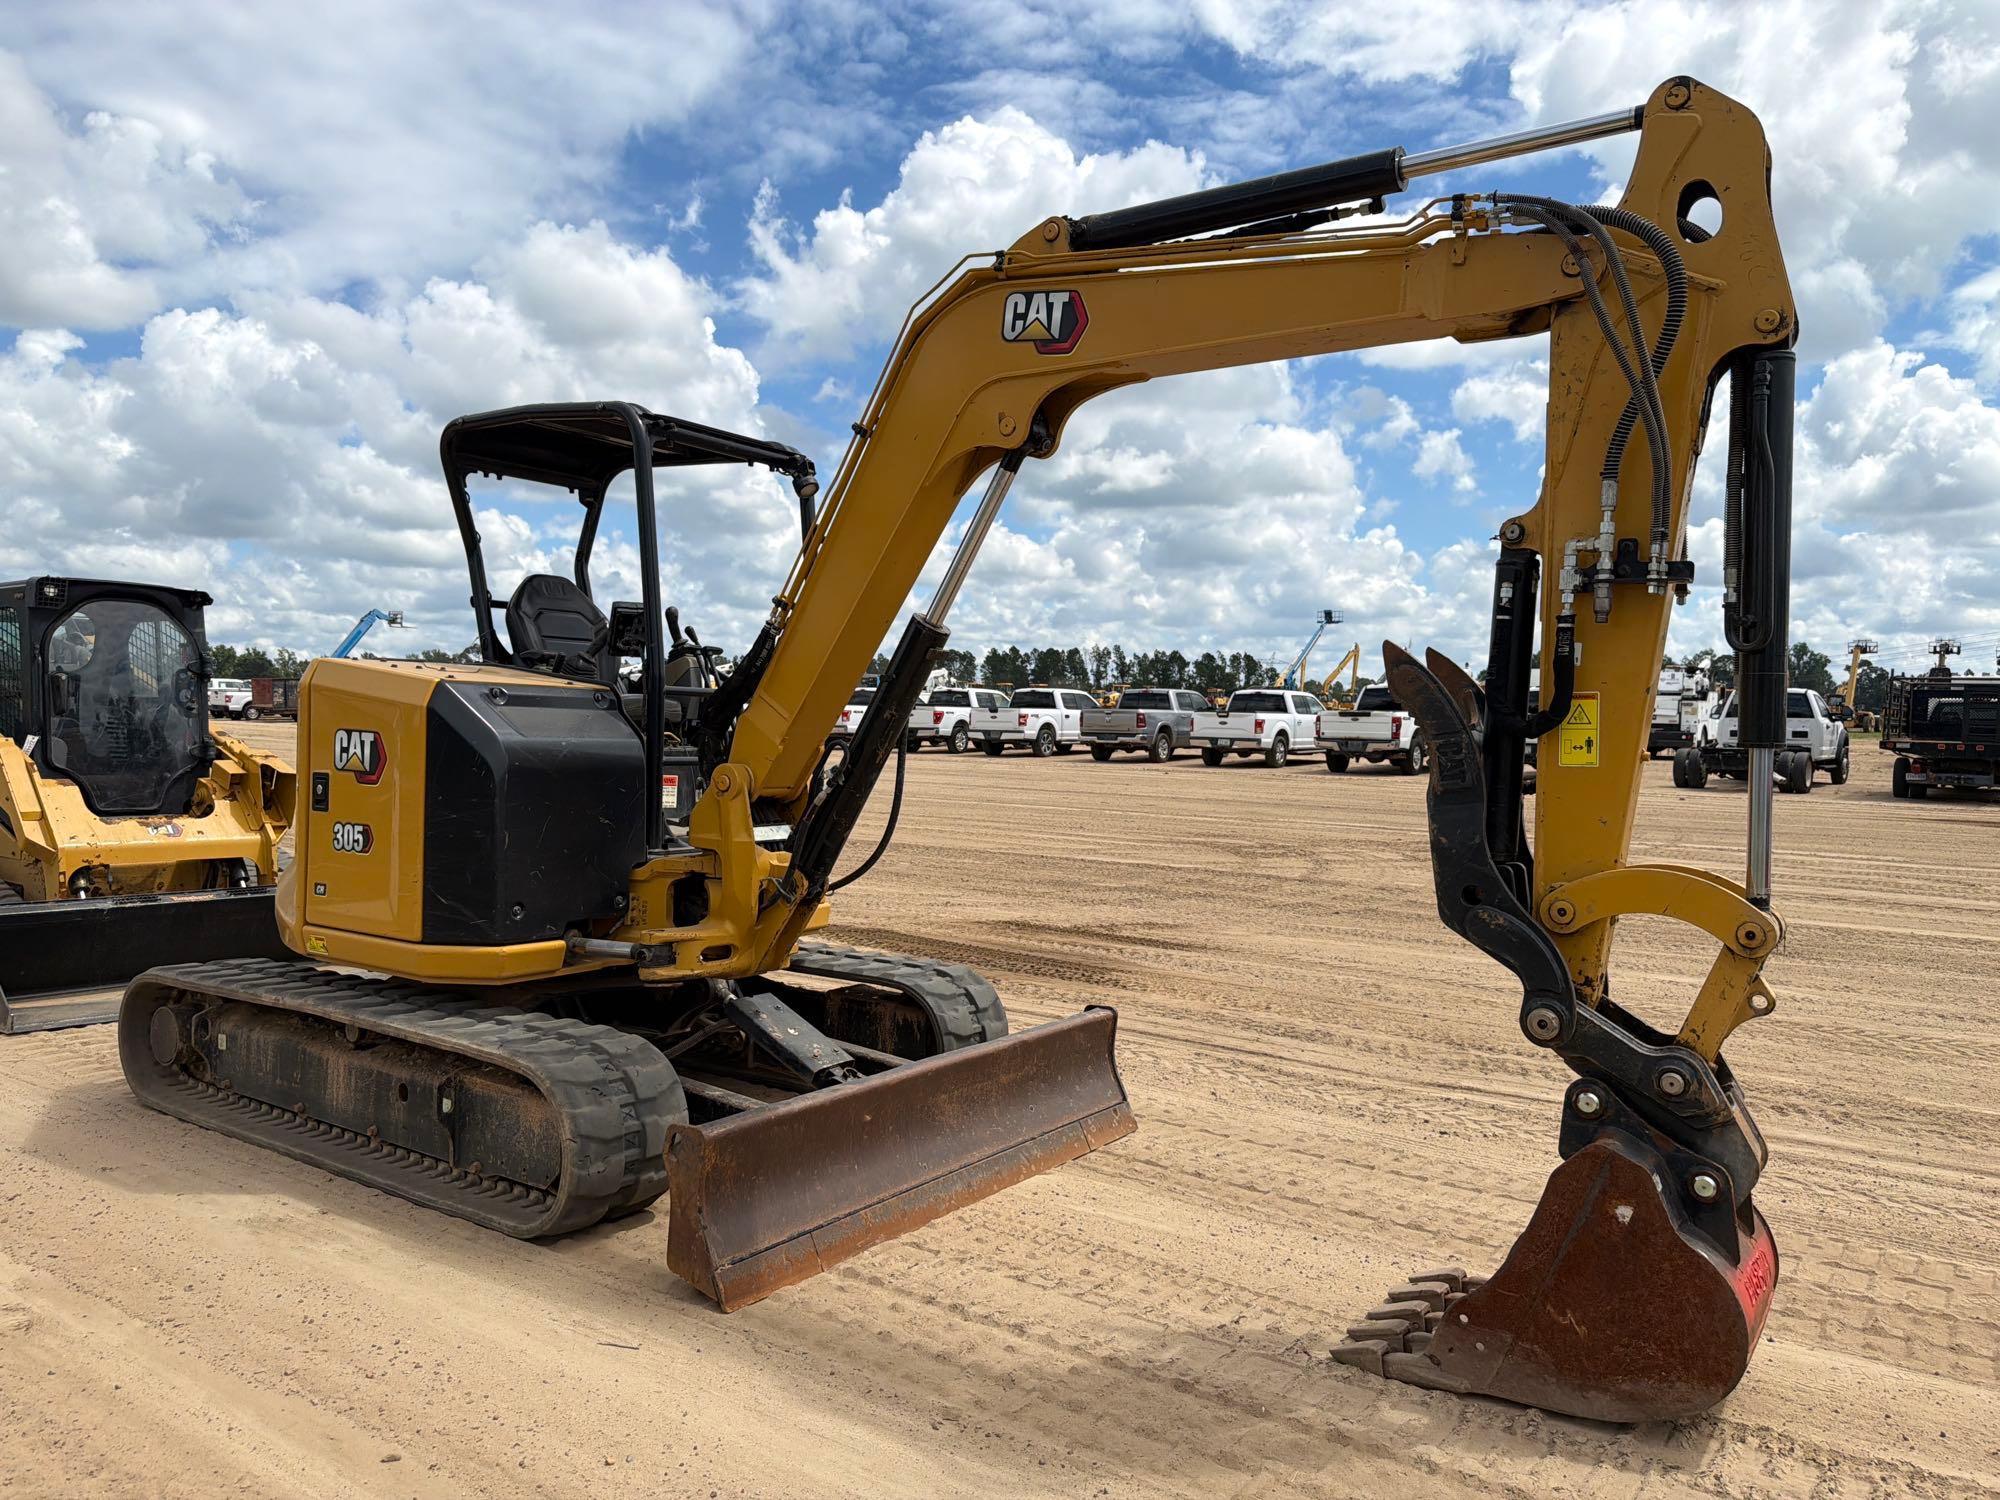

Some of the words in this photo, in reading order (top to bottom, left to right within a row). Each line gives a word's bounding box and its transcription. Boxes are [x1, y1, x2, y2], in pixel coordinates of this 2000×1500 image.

[1003, 292, 1070, 340] CAT
[335, 729, 375, 772] CAT
[333, 822, 364, 851] 305
